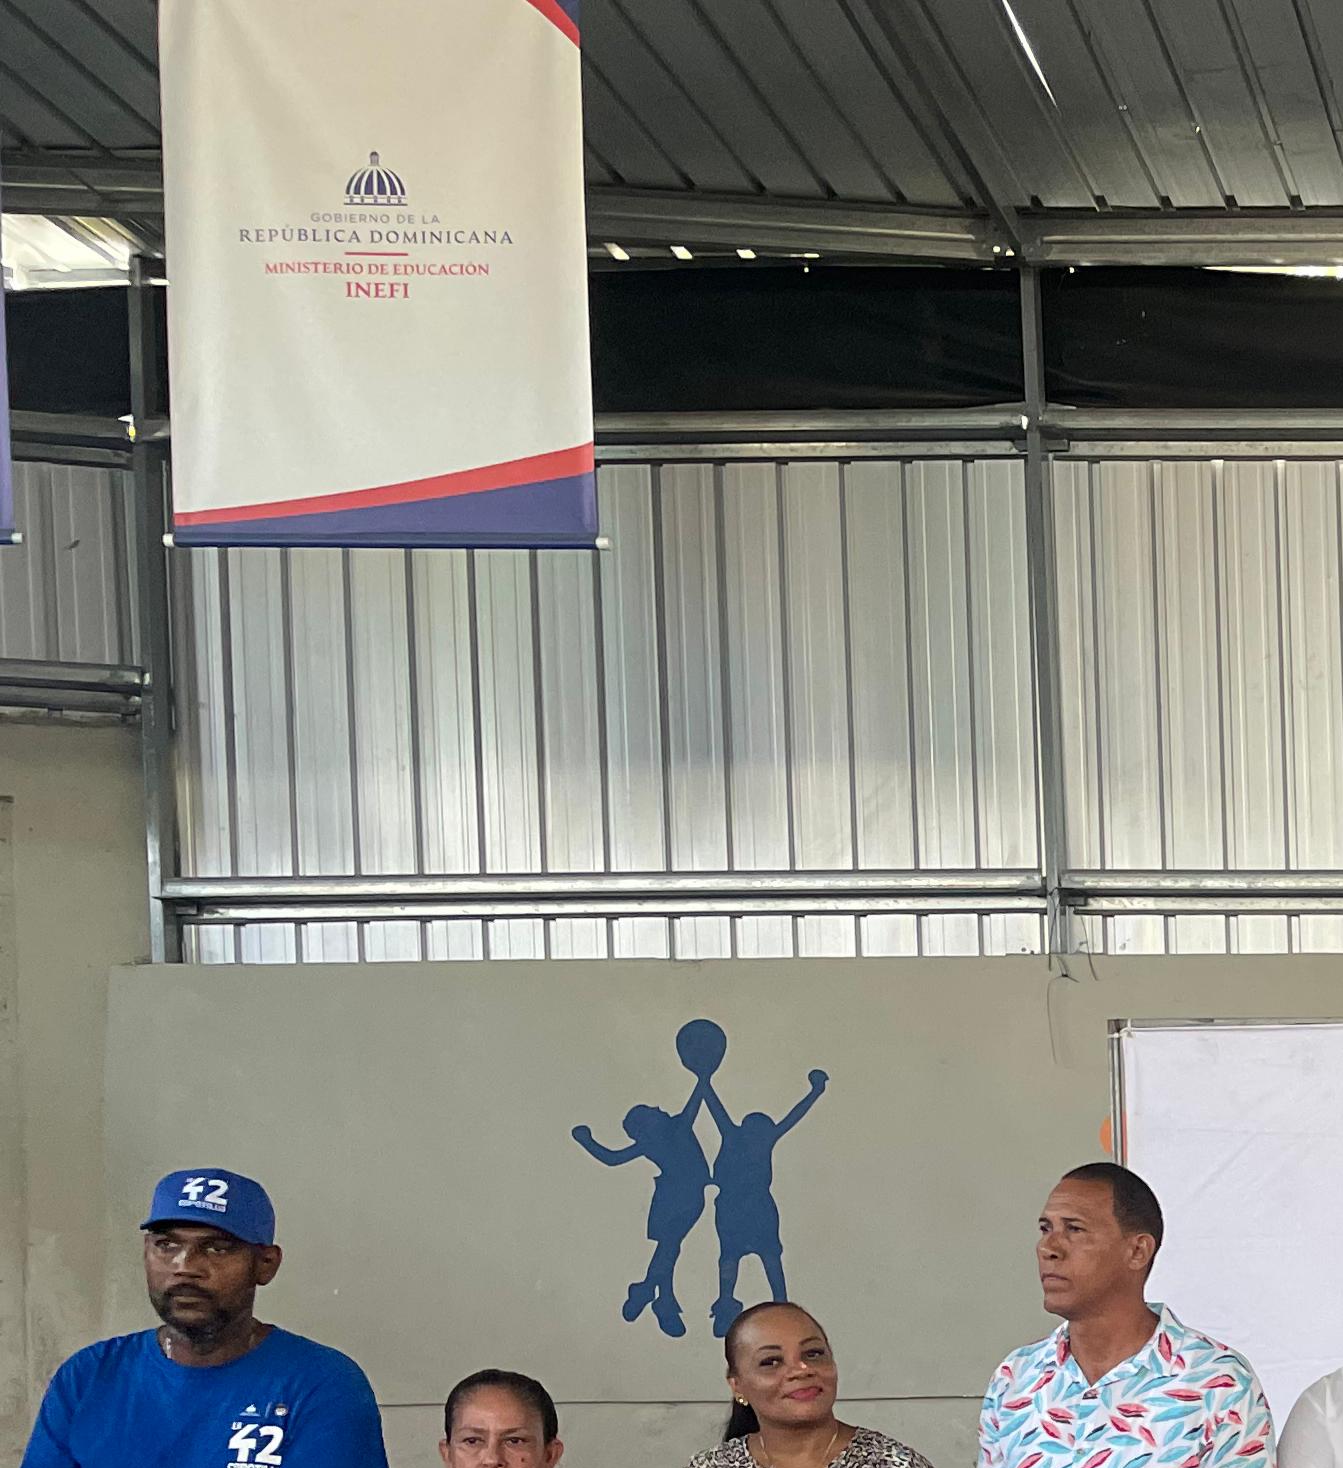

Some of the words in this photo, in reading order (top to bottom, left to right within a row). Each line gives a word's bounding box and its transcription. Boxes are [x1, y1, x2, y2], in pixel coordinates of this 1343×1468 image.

[310, 212, 390, 224] GOBIERNO
[396, 212, 415, 224] DE
[422, 213, 441, 224] LA
[239, 224, 361, 243] REPÚBLICA
[370, 229, 514, 245] DOMINICANA
[265, 261, 364, 275] MINISTERIO
[368, 263, 389, 275] DE
[393, 260, 490, 276] EDUCACIÓN
[345, 281, 410, 299] INEFI
[181, 1177, 228, 1205] 42
[228, 1424, 284, 1466] 42
